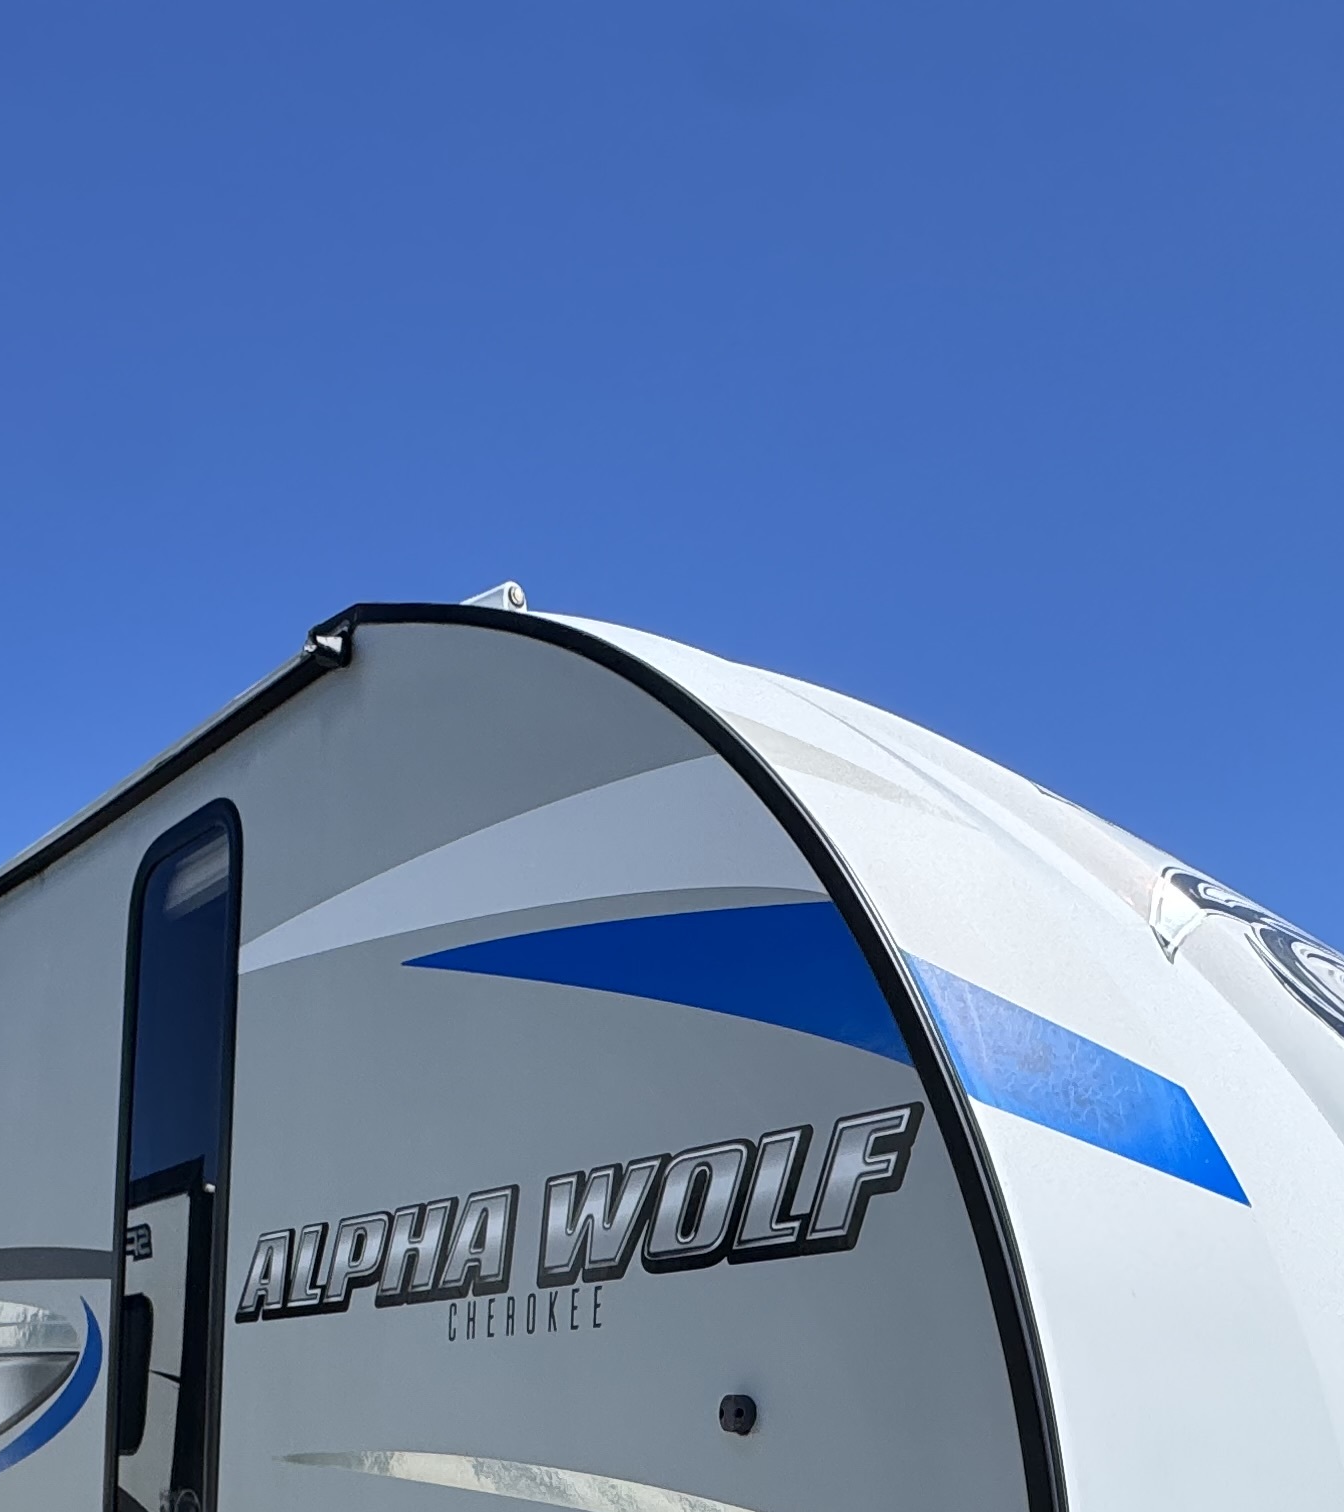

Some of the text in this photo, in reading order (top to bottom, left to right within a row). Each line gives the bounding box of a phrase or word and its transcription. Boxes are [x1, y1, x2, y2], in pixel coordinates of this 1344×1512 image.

[235, 1101, 924, 1324] ALPHA WOLF
[448, 1286, 604, 1341] CHEROKEE
